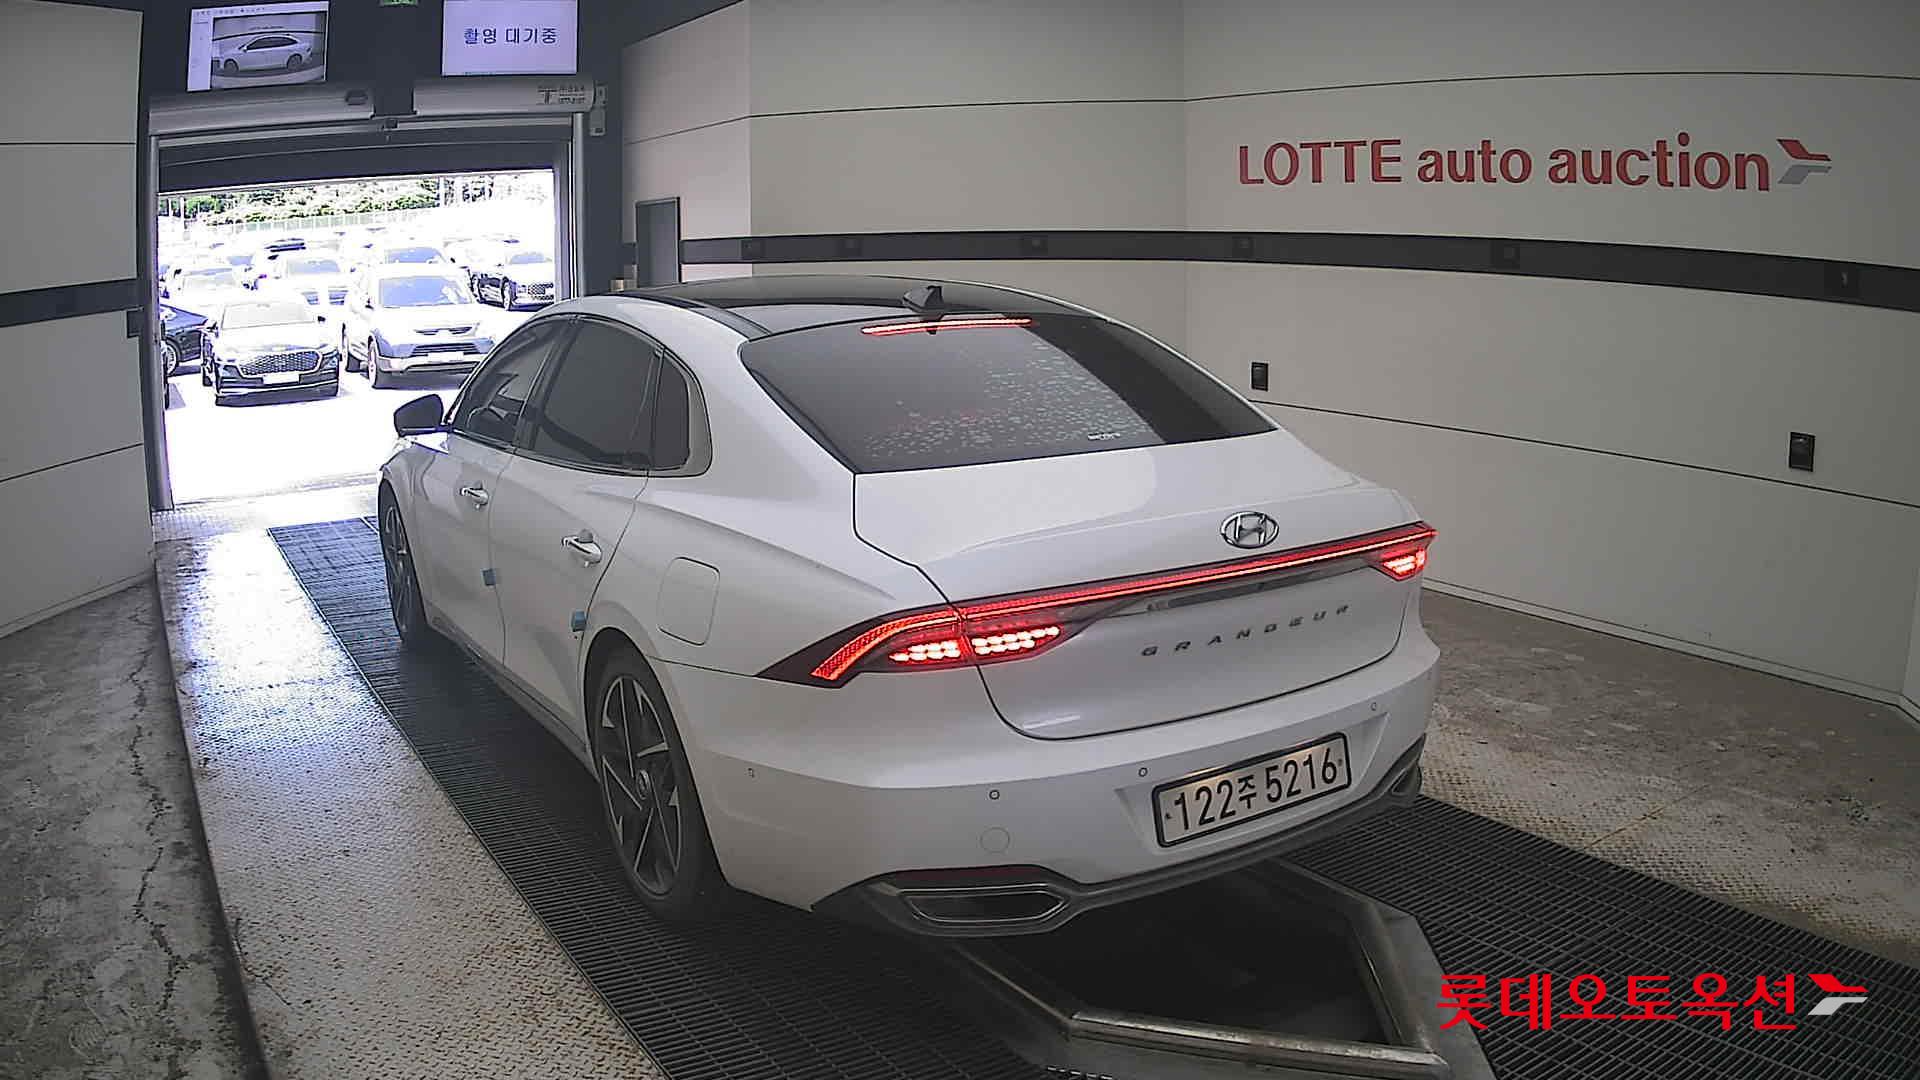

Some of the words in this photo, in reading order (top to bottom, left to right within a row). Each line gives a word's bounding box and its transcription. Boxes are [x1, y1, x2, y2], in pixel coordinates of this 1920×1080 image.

[505, 27, 557, 45] 대기중
[1238, 138, 1401, 186] LOTTE
[1417, 138, 1533, 185] auto
[1547, 131, 1771, 192] auction
[1141, 604, 1350, 657] GRANDEUR
[1264, 747, 1338, 803] 5216
